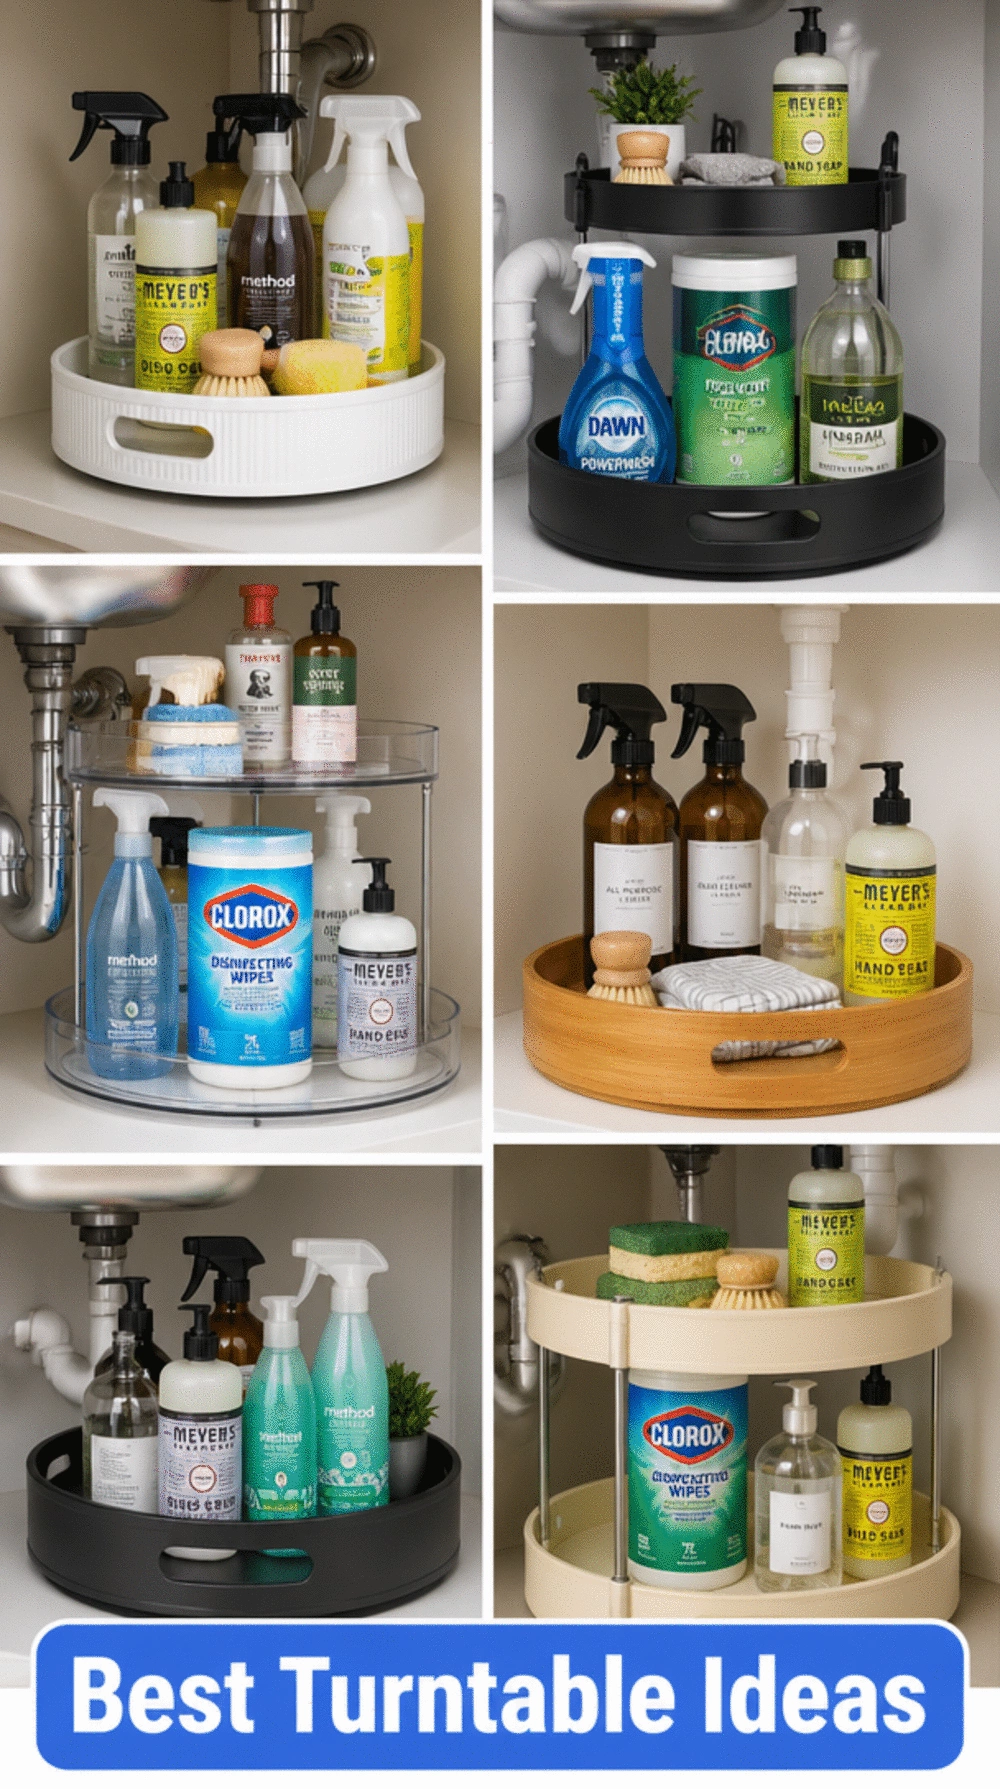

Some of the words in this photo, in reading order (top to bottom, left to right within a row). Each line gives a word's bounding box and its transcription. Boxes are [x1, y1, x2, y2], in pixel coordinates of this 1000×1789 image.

[241, 273, 296, 288] method
[588, 415, 645, 437] DAWN
[211, 903, 292, 929] CLOROX
[854, 960, 894, 976] HAND
[230, 971, 274, 985] WIPES
[650, 1422, 725, 1447] CLOROX
[669, 1485, 711, 1498] WIPES
